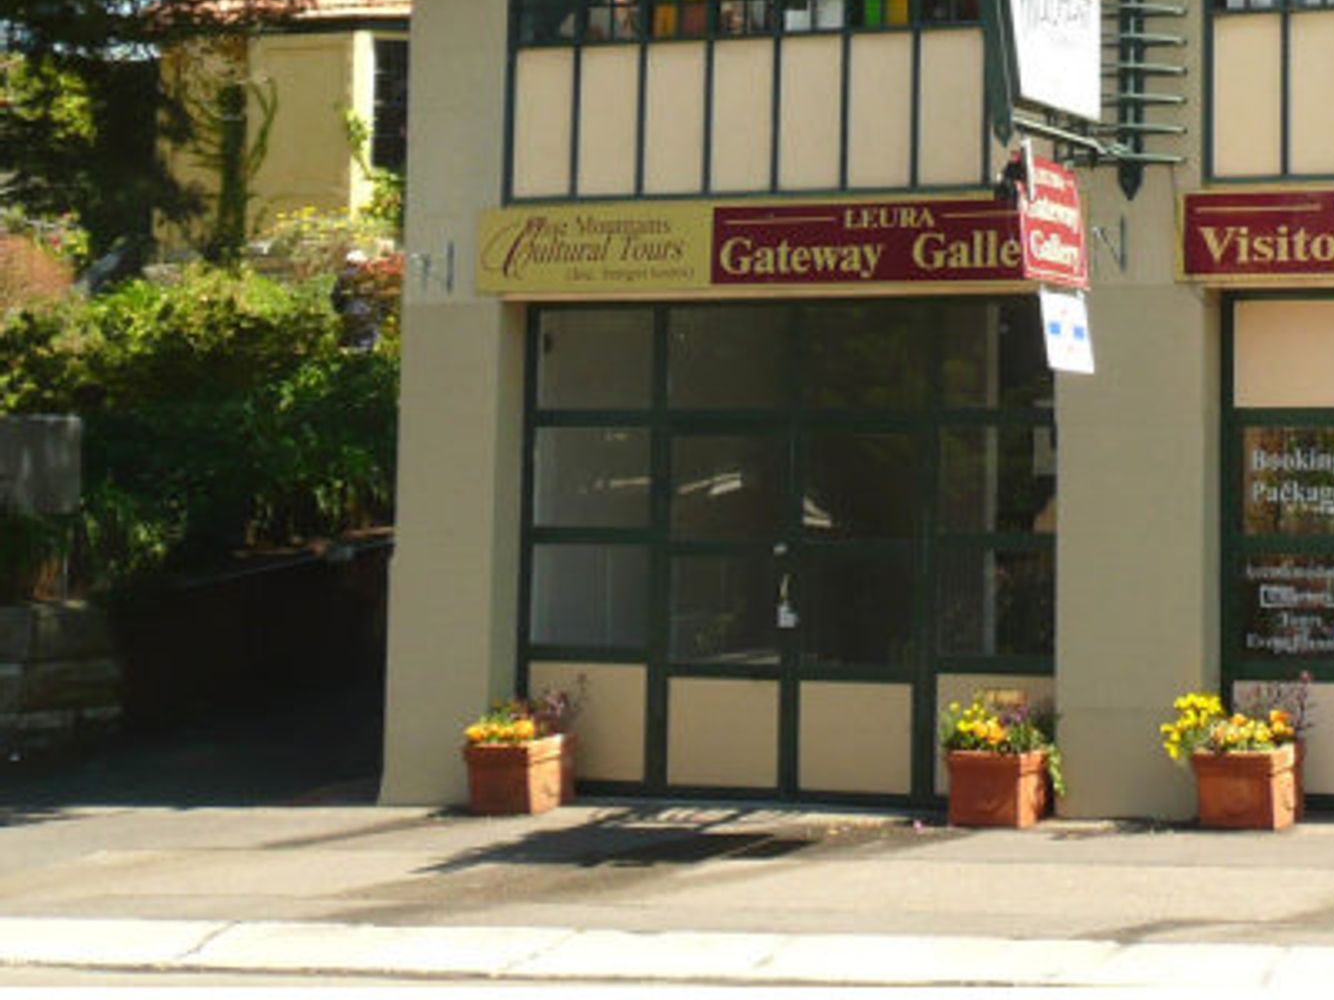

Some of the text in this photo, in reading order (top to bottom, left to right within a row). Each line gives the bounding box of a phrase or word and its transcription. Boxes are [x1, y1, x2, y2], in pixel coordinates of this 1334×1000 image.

[844, 208, 936, 229] LEURA
[619, 233, 685, 263] Tours
[718, 229, 1023, 277] Gateway Galle
